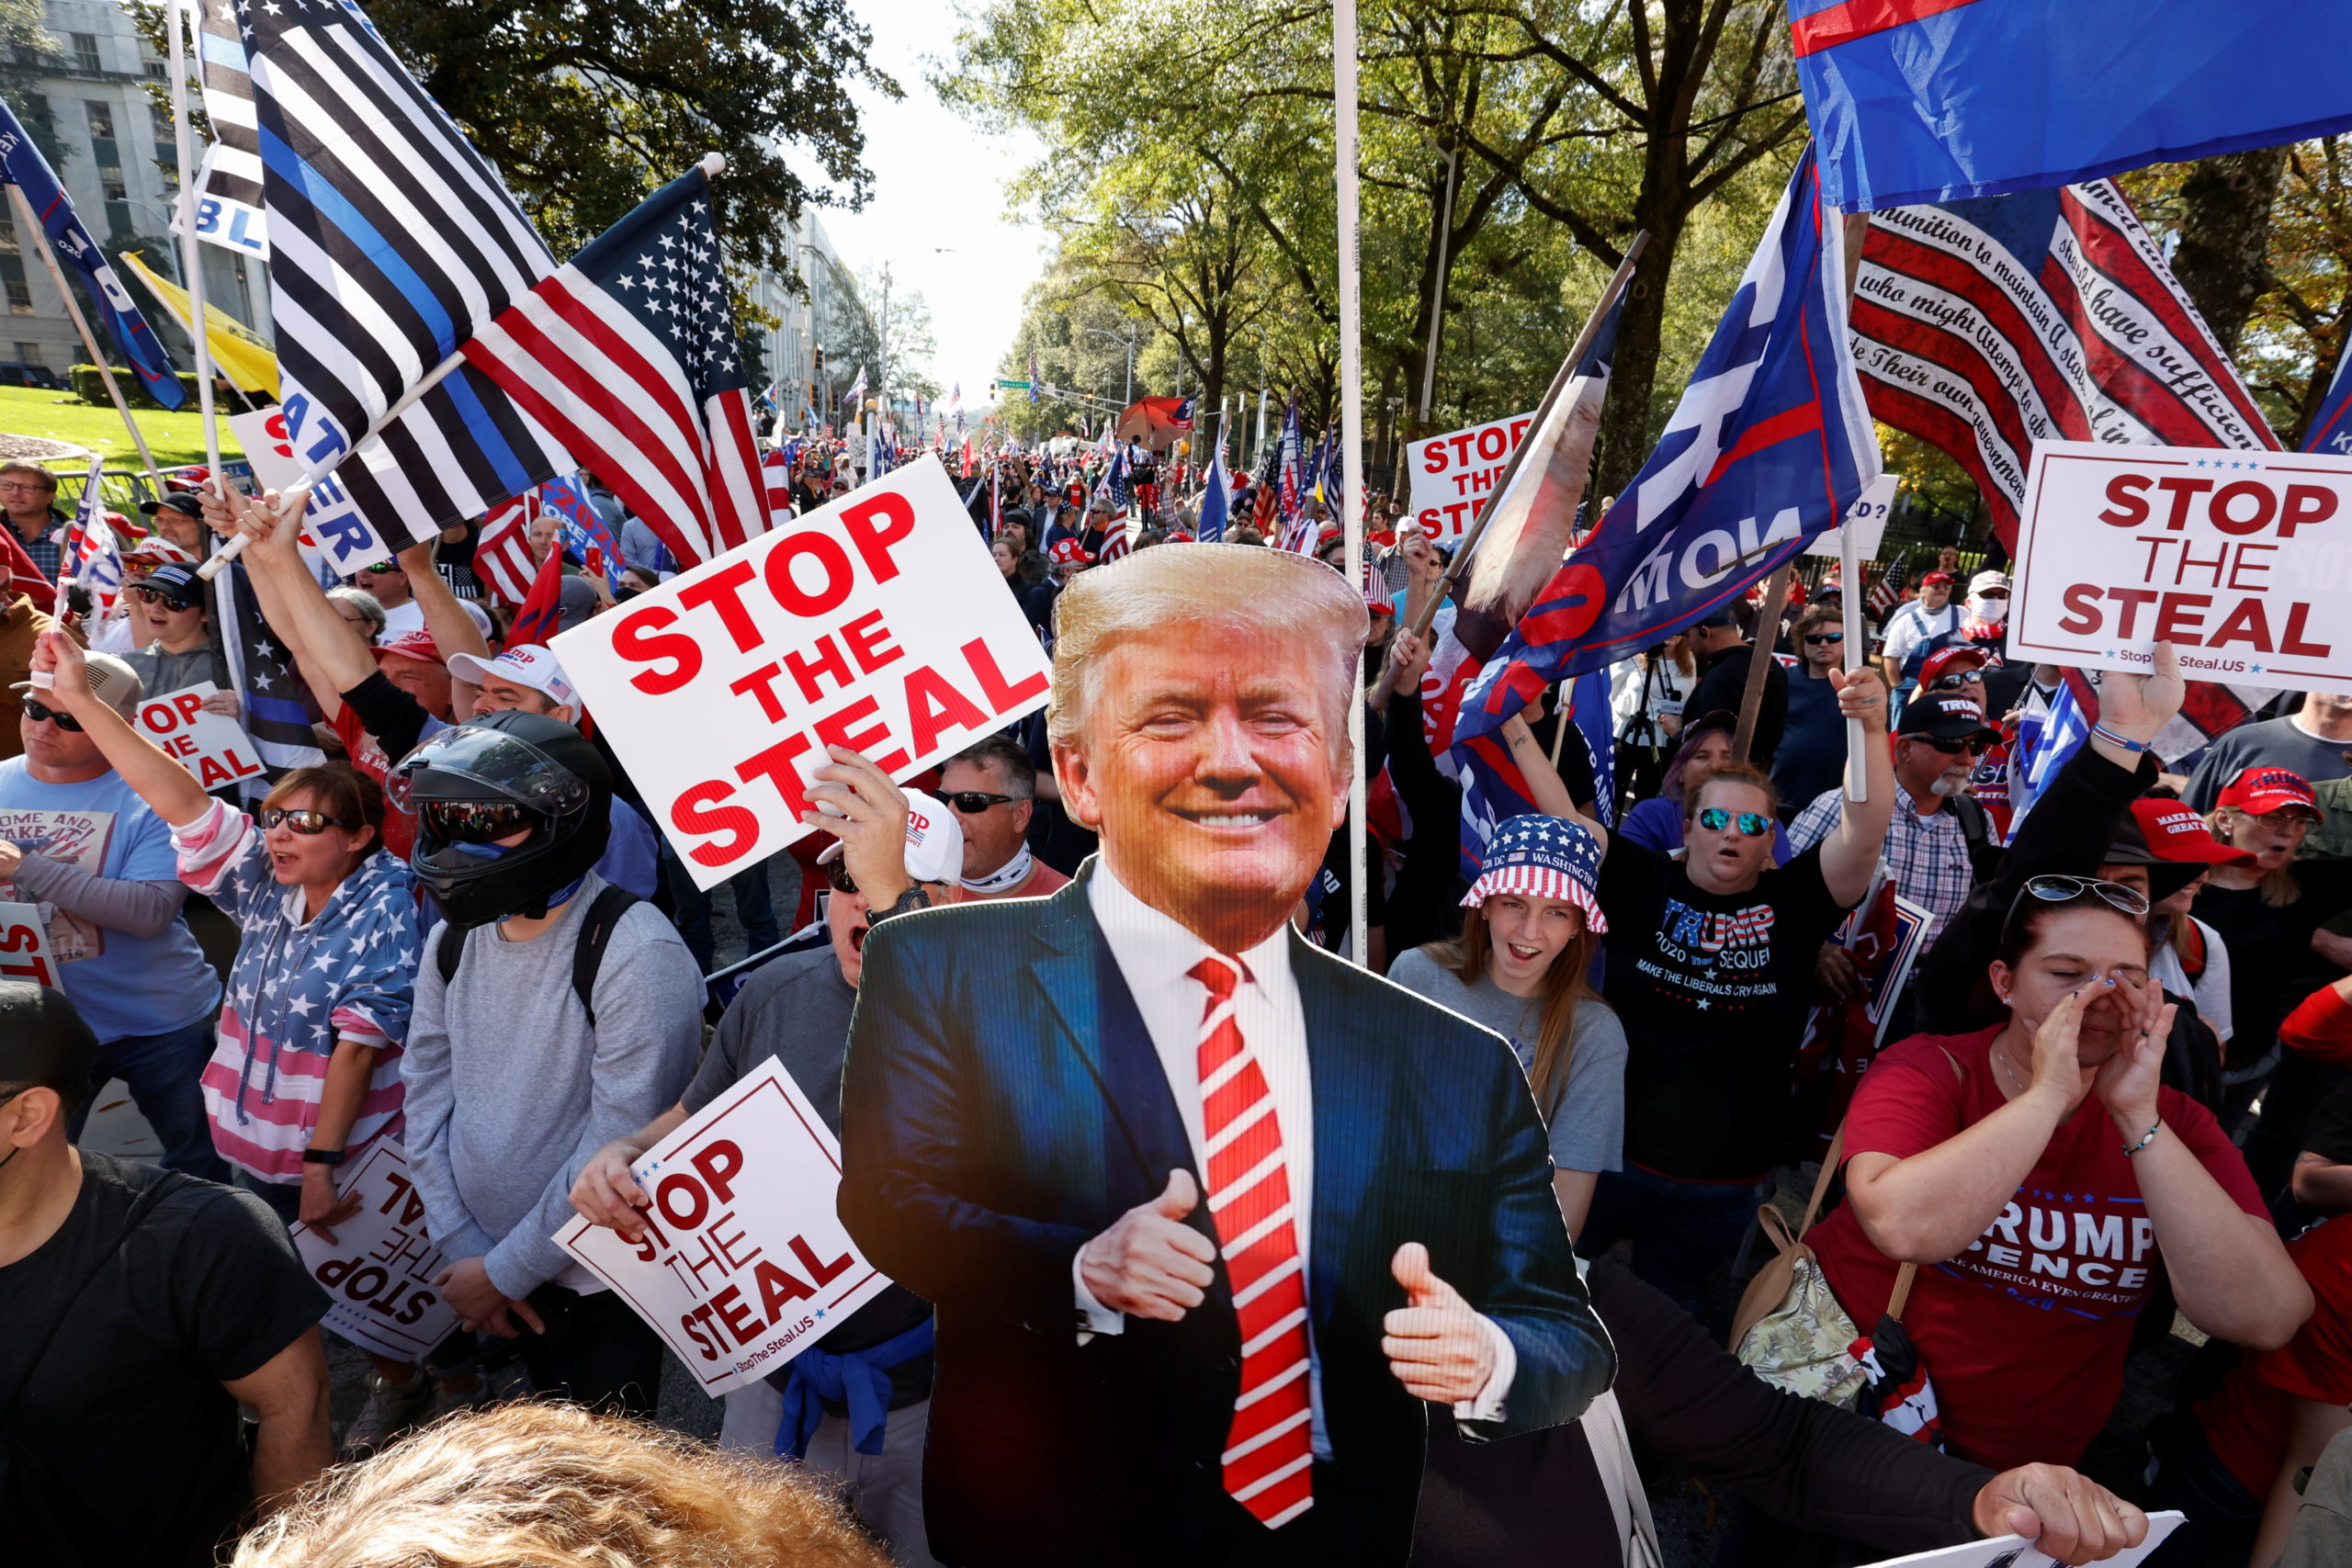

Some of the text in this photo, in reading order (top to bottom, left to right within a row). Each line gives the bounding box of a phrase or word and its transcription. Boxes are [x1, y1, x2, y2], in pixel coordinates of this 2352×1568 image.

[56, 239, 83, 260] 020
[1975, 242, 1992, 265] to
[1994, 259, 2050, 333] maintain
[2049, 323, 2067, 351] A
[1860, 274, 1905, 303] who
[1910, 298, 1975, 333] might
[2020, 389, 2032, 414] to
[2059, 237, 2259, 450] should have sufficien
[1869, 347, 1928, 387] Their
[1933, 375, 1973, 413] own
[542, 501, 587, 544] ORE
[2098, 473, 2339, 538] STOP
[2136, 536, 2279, 592] THE
[611, 491, 915, 695] STOP
[2058, 582, 2332, 659] STEAL
[729, 607, 905, 724] THE
[132, 693, 202, 734] OP
[184, 749, 261, 788] AL
[671, 637, 1050, 867] STEAL
[0, 812, 93, 831] OME AND
[2156, 813, 2188, 826] MAKE
[2166, 822, 2199, 834] GREAT
[1494, 855, 1506, 865] DC
[1656, 931, 1687, 963] 2020
[1662, 897, 1775, 953] TRUMP
[1635, 958, 1778, 998] MAKE THE LIBERALS CRY AGAIN
[368, 1226, 443, 1284] THE
[663, 1211, 763, 1300] THE
[1969, 1263, 2038, 1289] AMERICA
[315, 1256, 437, 1325] STOP
[681, 1234, 855, 1361] STEAL
